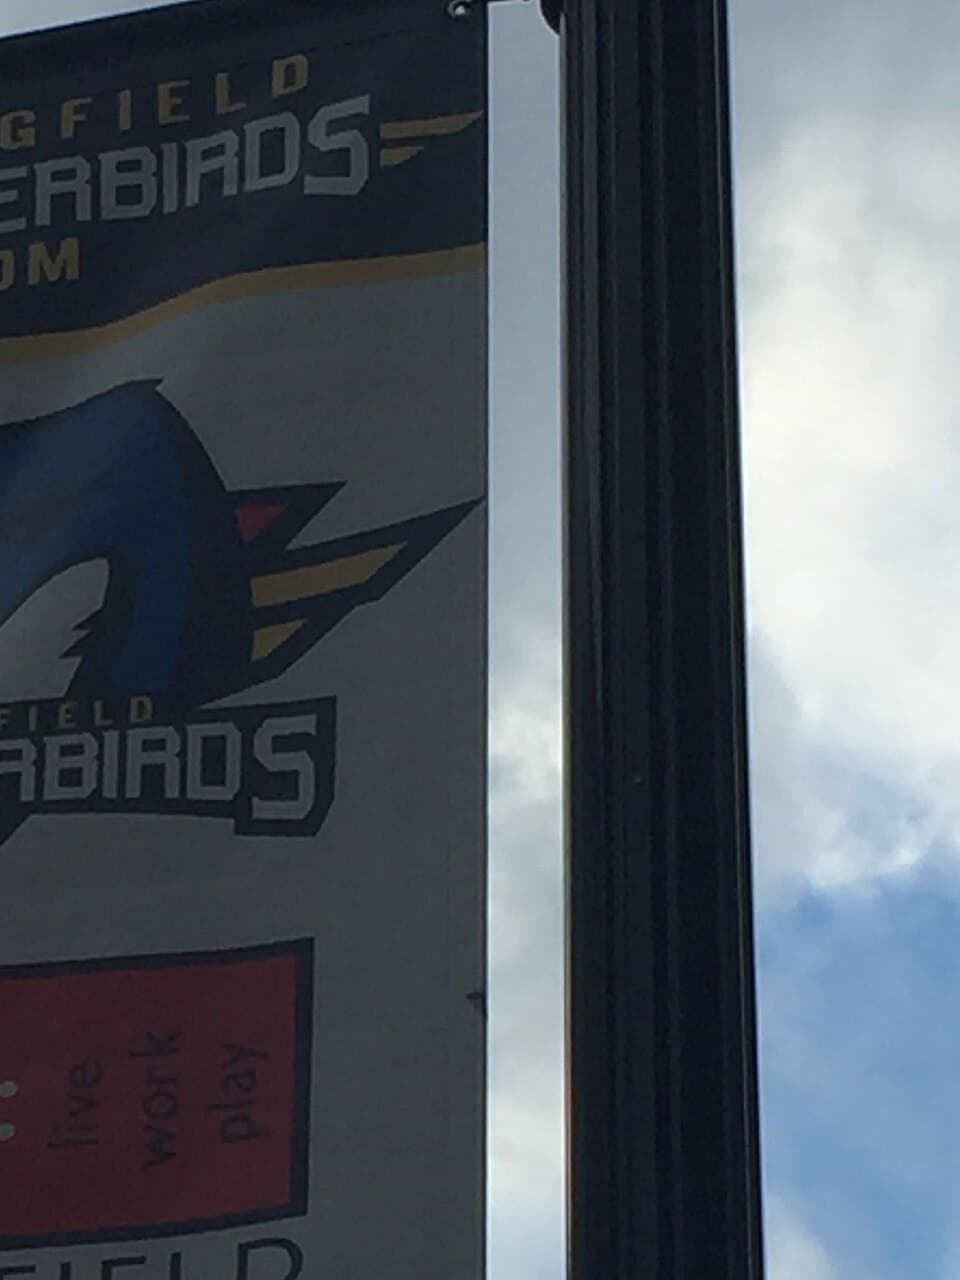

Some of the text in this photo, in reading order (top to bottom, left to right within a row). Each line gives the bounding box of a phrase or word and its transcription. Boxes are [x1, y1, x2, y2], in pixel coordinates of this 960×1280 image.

[49, 1057, 106, 1150] live
[129, 1028, 182, 1170] work
[205, 1041, 270, 1145] play
